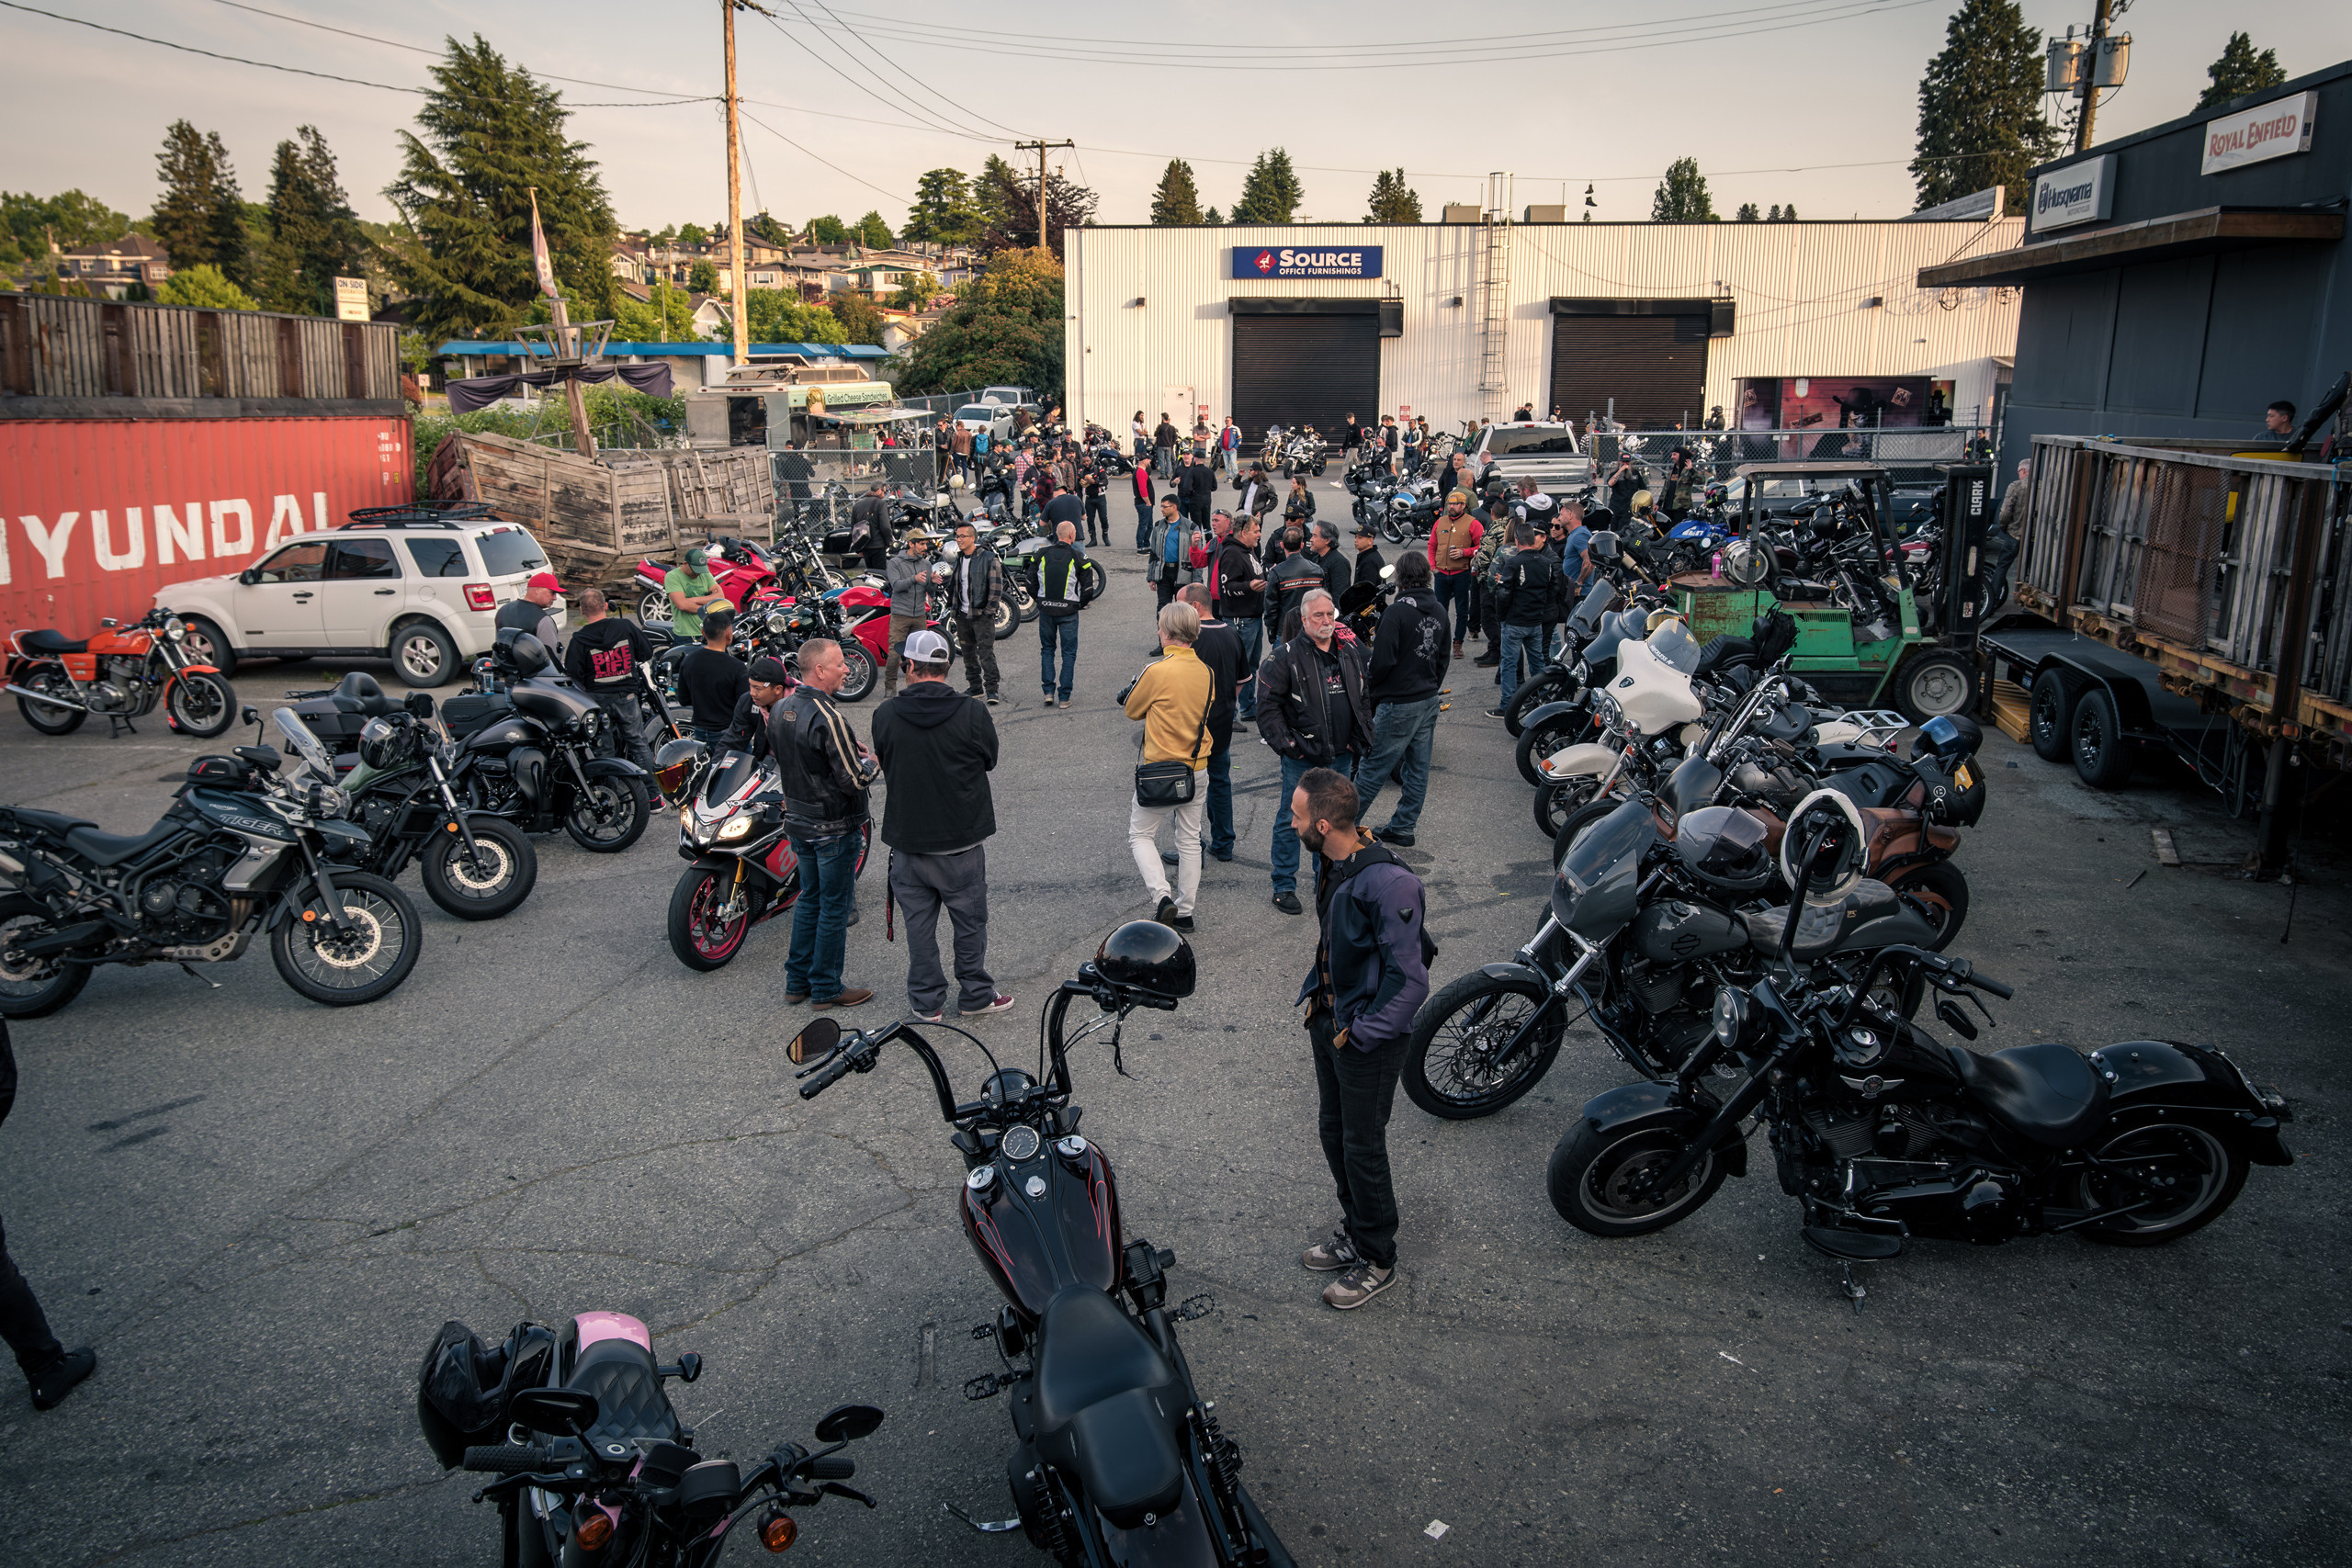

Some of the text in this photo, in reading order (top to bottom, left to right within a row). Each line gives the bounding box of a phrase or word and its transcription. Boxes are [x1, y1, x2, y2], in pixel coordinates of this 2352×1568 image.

[2209, 114, 2297, 157] ROYAL ENFIELD
[2048, 182, 2092, 209] Husqvarna
[1279, 249, 1363, 267] SOURCE
[338, 279, 348, 288] ON
[827, 391, 888, 404] Grilled Cheese Sandwiches
[1971, 480, 1984, 515] CLARK
[0, 491, 327, 585] YUNDAI
[592, 645, 632, 665] BIKE
[594, 657, 632, 674] LIFE
[220, 814, 285, 836] TIGER
